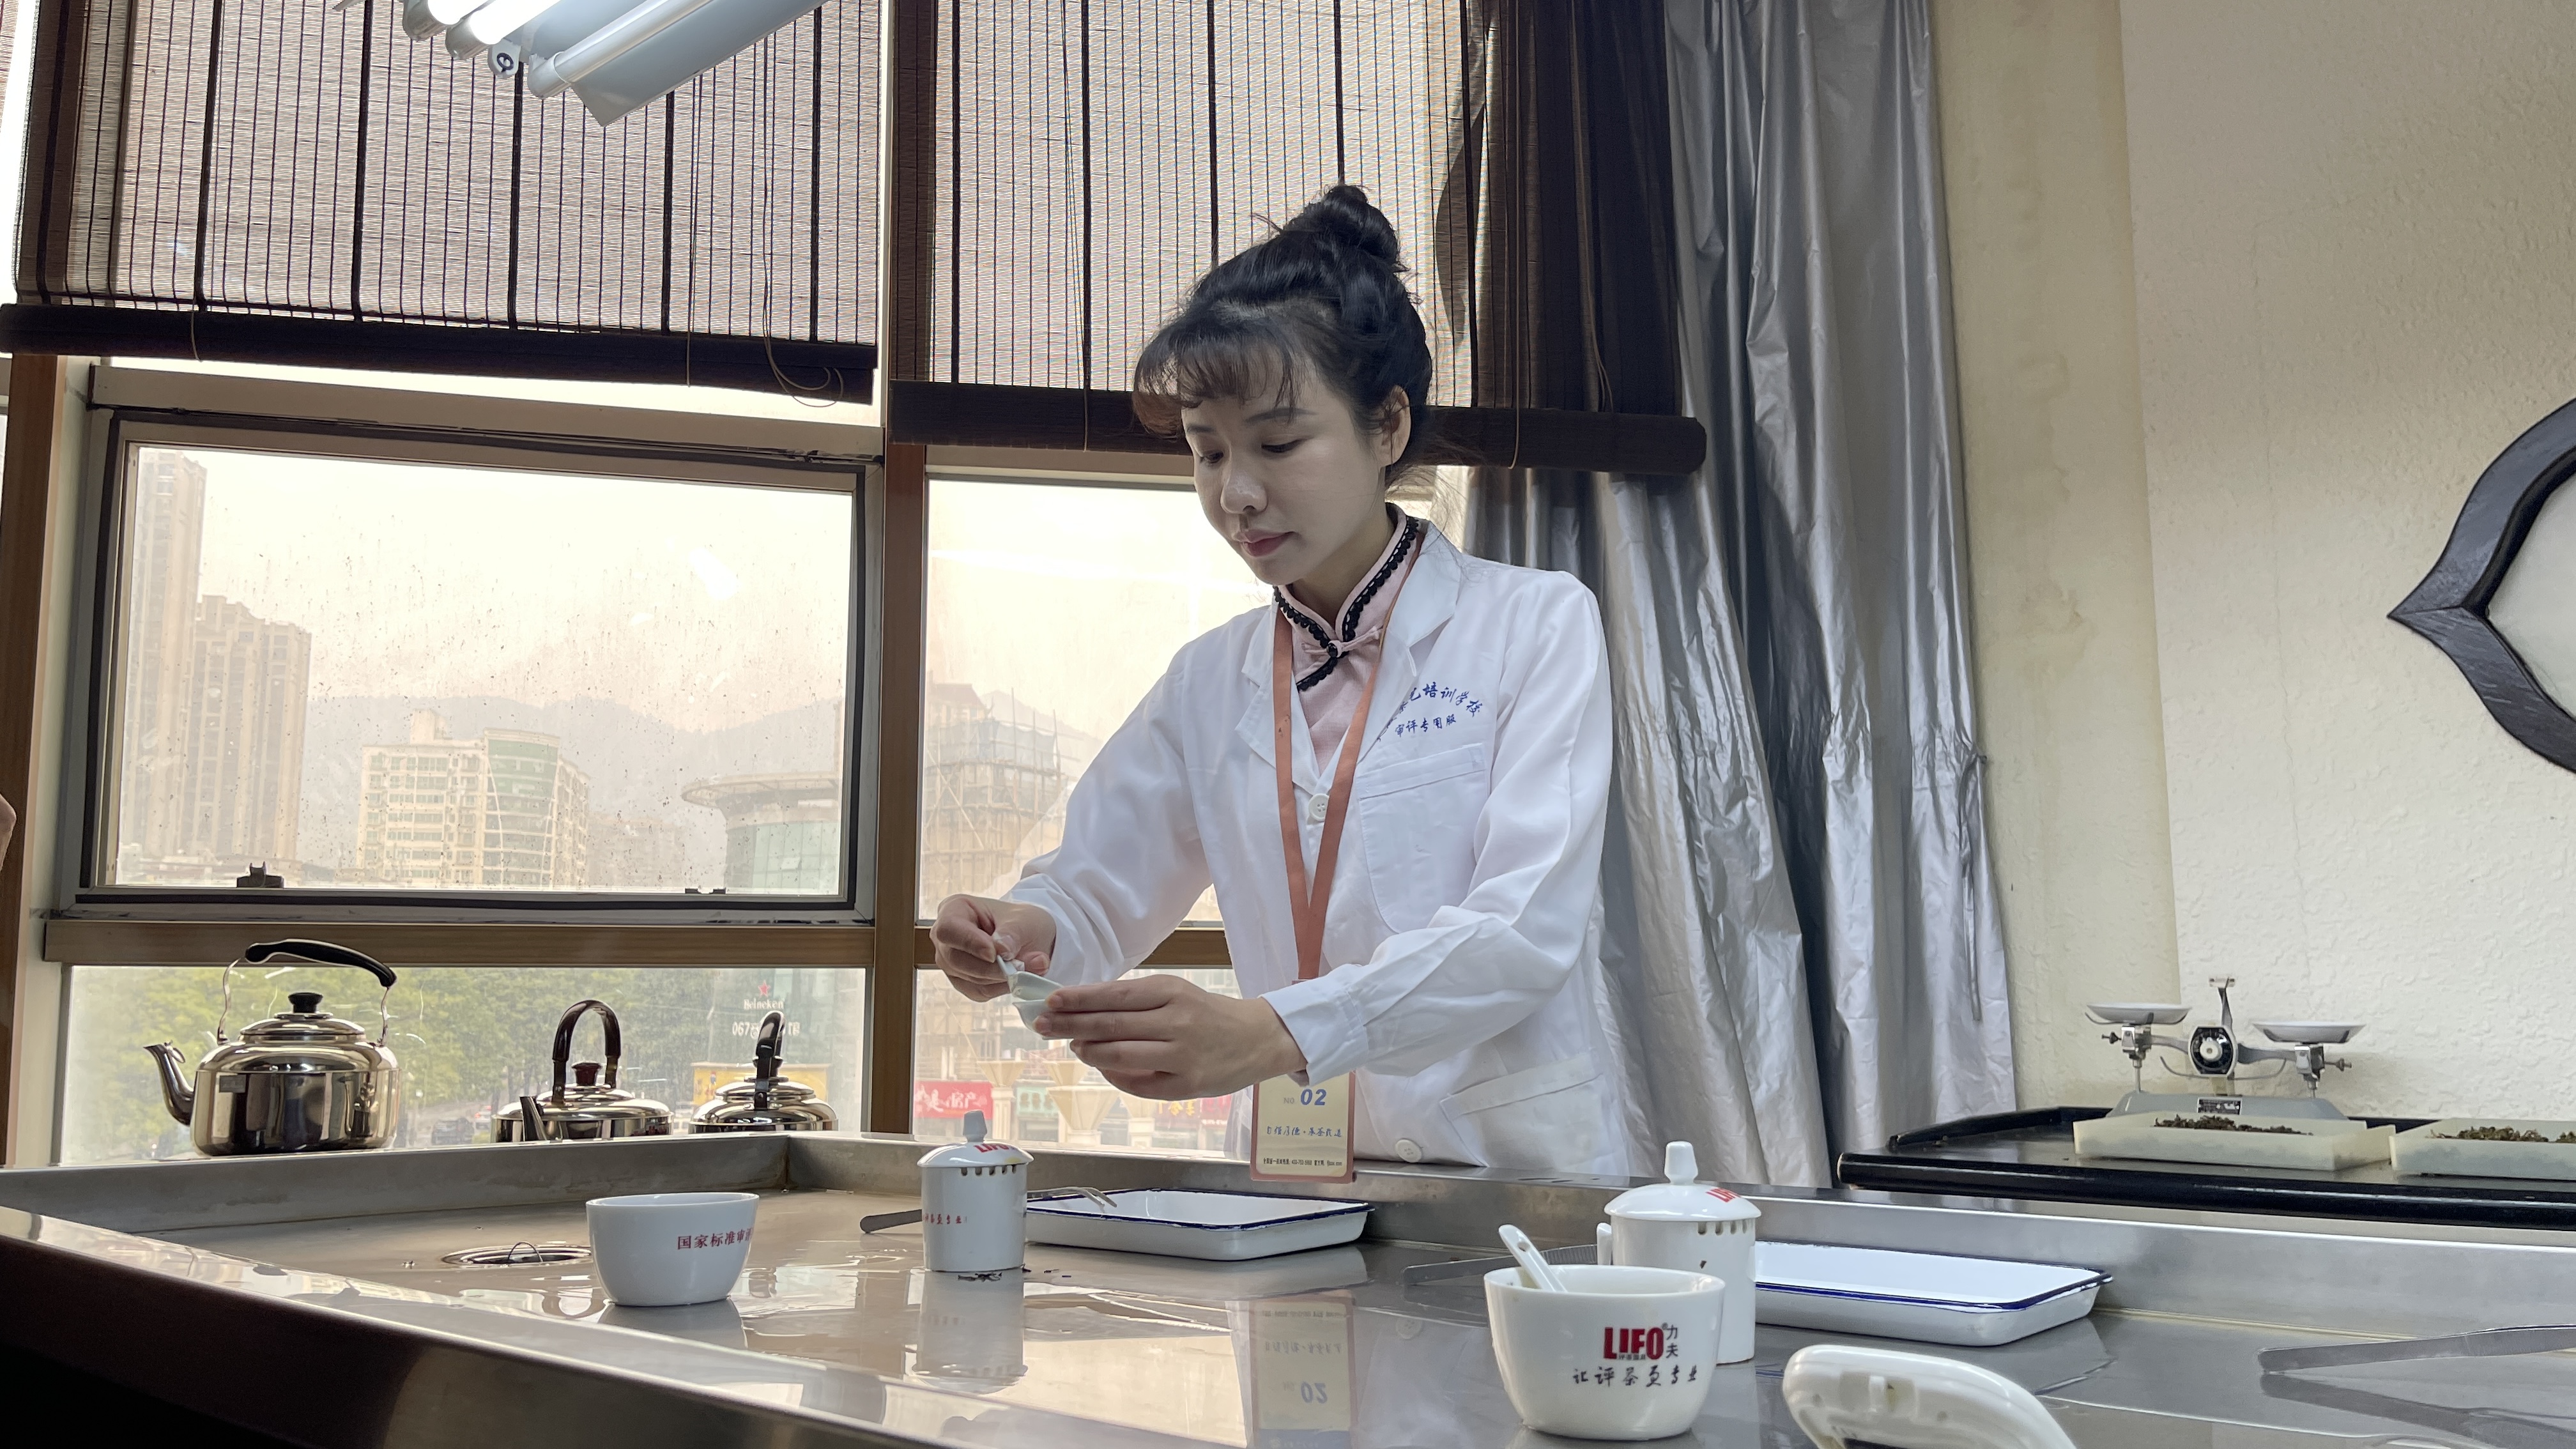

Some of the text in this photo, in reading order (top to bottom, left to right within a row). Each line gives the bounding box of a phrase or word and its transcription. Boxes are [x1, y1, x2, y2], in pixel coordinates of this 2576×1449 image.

[1395, 714, 1457, 737] 审评专用服
[744, 998, 785, 1009] Heineken
[1300, 1088, 1327, 1106] 02
[1604, 1327, 1664, 1360] LIFO
[1666, 1324, 1678, 1359] 力夫
